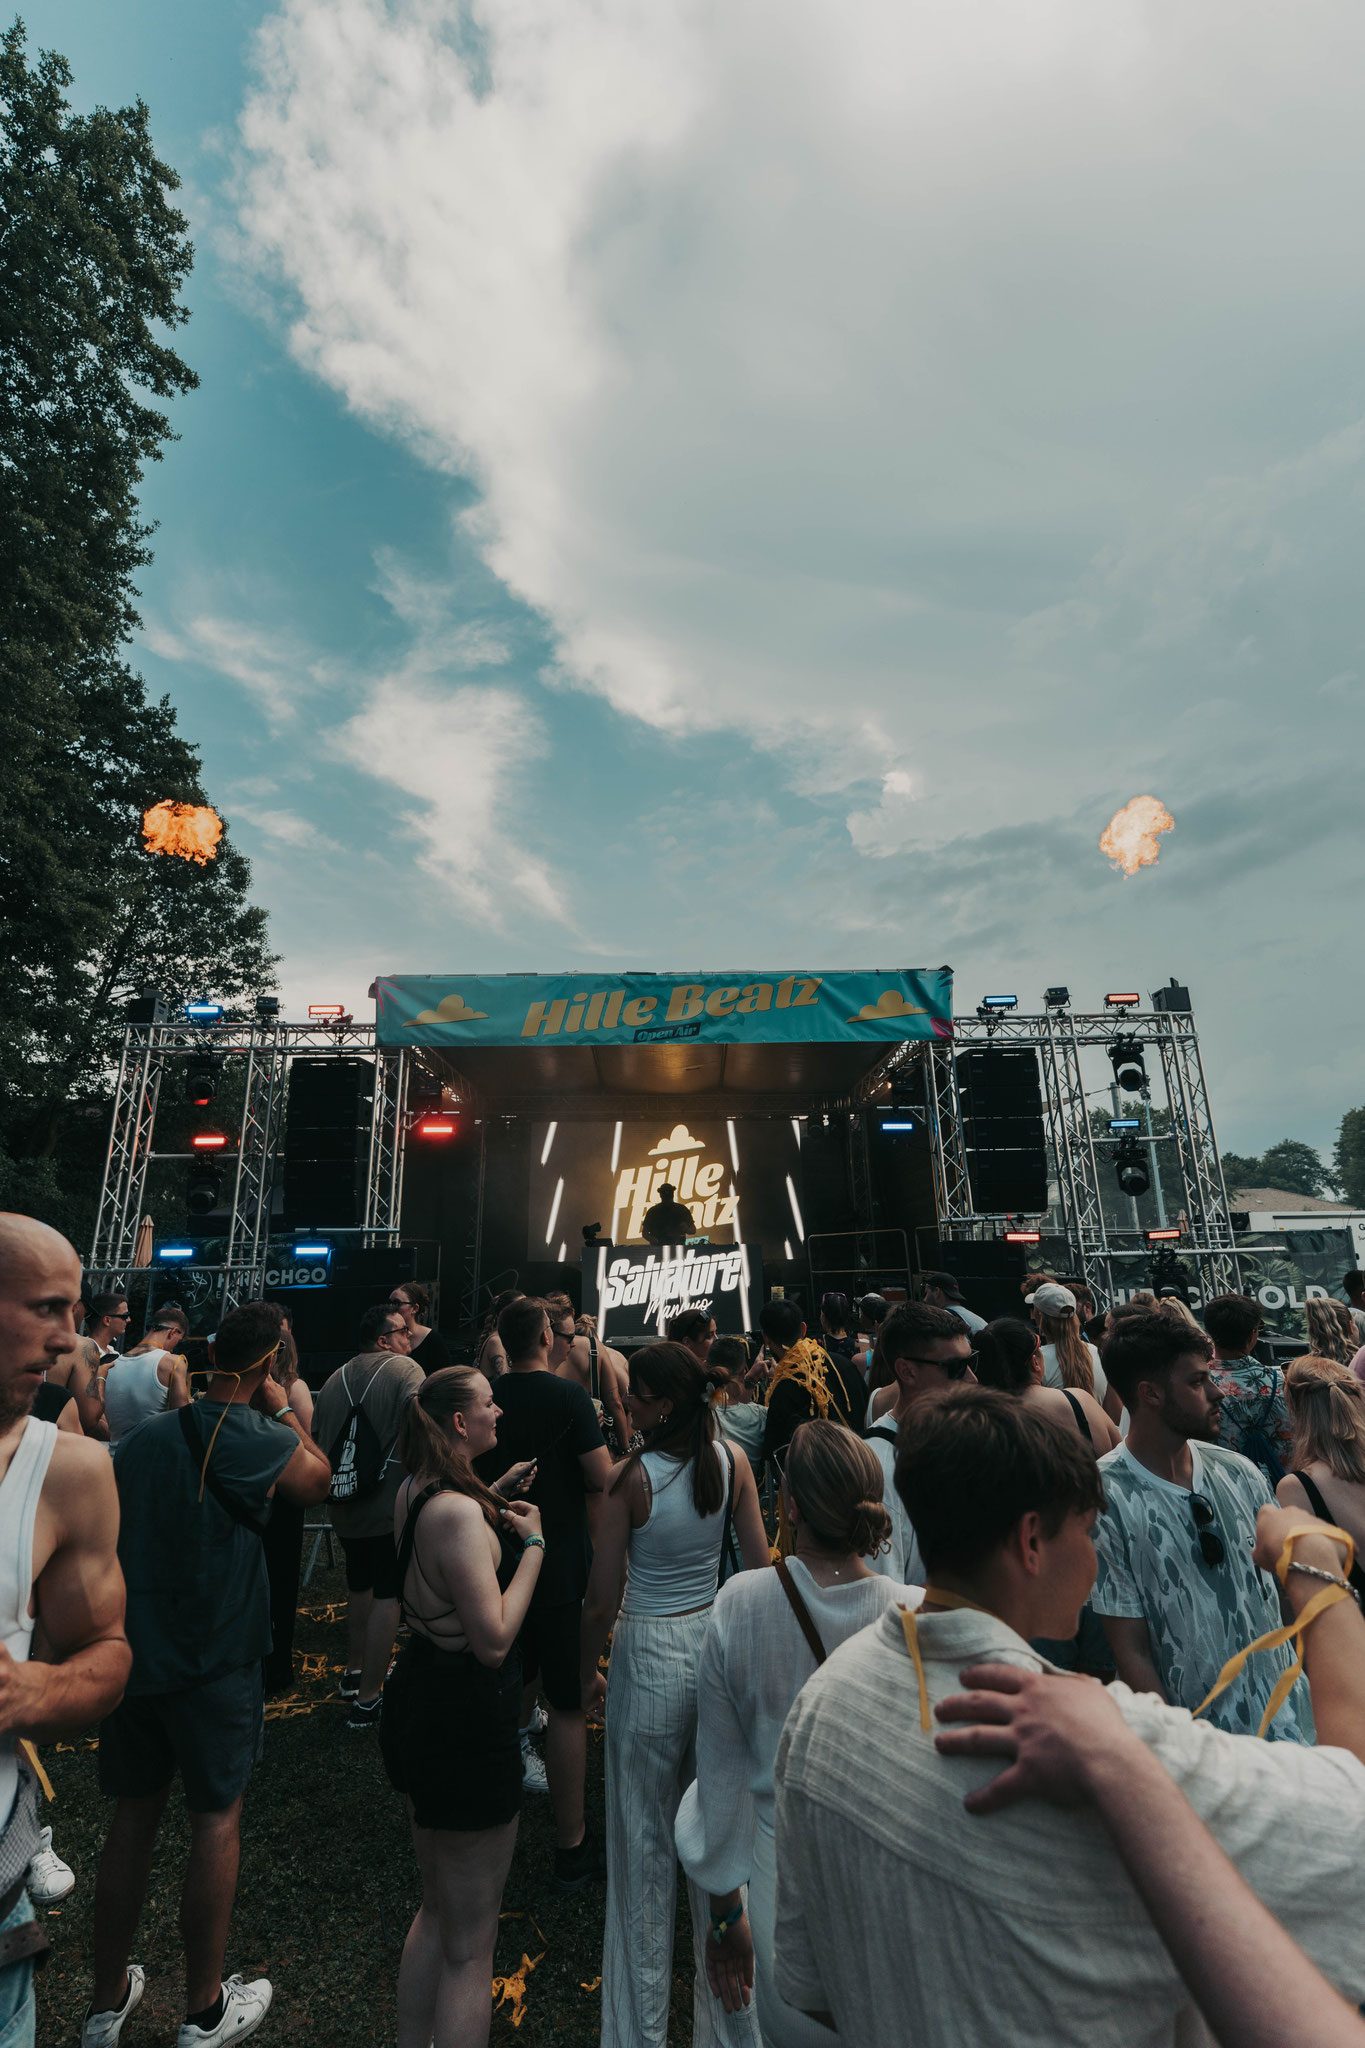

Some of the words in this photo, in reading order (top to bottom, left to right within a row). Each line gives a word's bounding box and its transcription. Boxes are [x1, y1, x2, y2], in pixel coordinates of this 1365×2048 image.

[521, 990, 657, 1037] Hille
[664, 975, 823, 1022] Beatz
[637, 1029, 674, 1041] Open
[673, 1025, 697, 1037] Air
[615, 1155, 724, 1209] Hille
[626, 1195, 740, 1240] Btz
[605, 1249, 742, 1309] Salvatore
